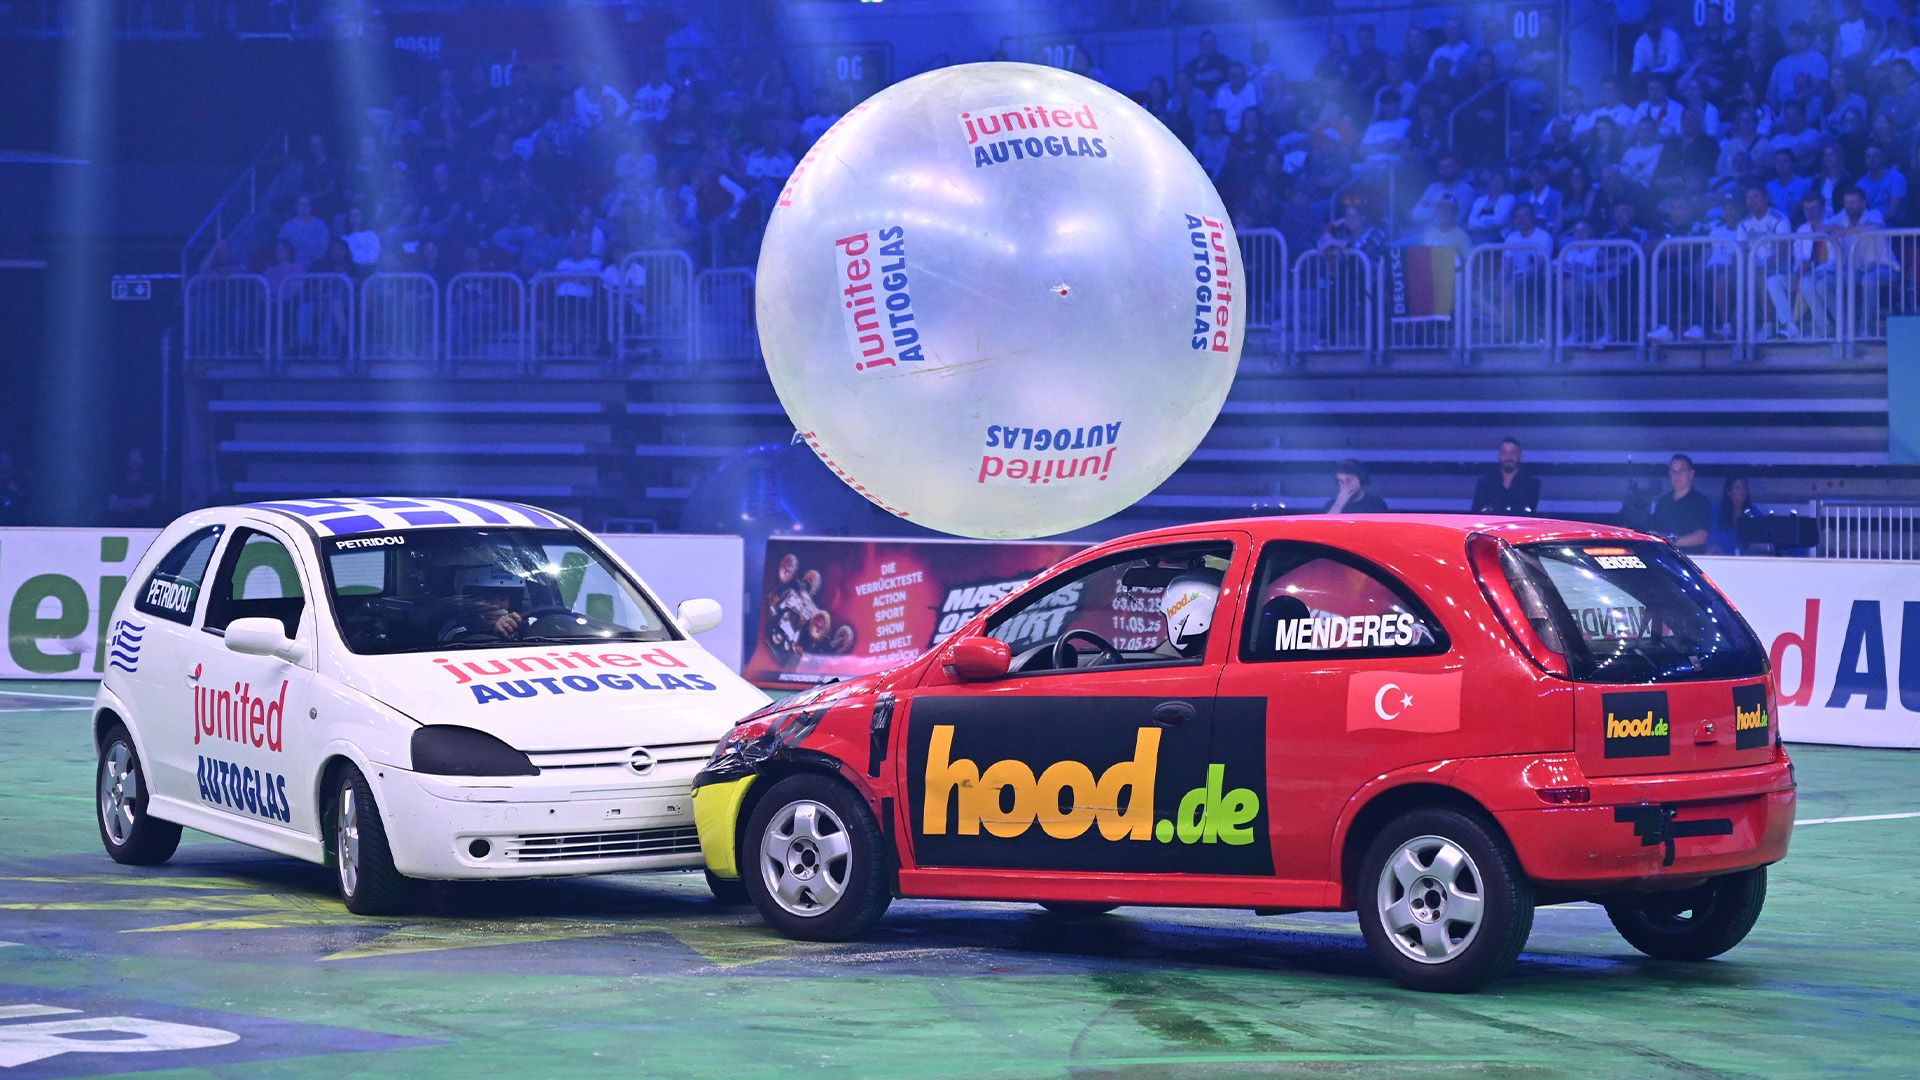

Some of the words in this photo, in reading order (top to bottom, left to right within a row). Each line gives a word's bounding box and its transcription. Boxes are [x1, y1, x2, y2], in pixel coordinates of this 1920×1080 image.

[962, 104, 1098, 145] junited
[974, 135, 1108, 169] AUTOGLAS
[879, 225, 925, 362] AUTOGLAS
[1184, 213, 1213, 351] AUTOGLAS
[1202, 215, 1233, 353] junited
[835, 232, 897, 371] junited
[985, 420, 1122, 452] AUTOGLAS
[977, 446, 1118, 484] junited
[335, 535, 405, 550] PETRIDOU
[855, 571, 924, 596] VERRÜCKTESTE
[881, 562, 897, 576] DIE
[146, 578, 193, 614] PETRIDOU
[873, 591, 907, 607] ACTION
[875, 606, 905, 622] SPORT
[876, 621, 905, 637] SHOW
[1112, 615, 1161, 633] 11.05.25
[869, 641, 888, 653] DER
[888, 635, 912, 649] WELT
[1275, 612, 1416, 651] MENDERES
[432, 648, 689, 685] junited
[469, 673, 717, 705] AUTOGLAS
[194, 663, 289, 752] junited
[1606, 710, 1668, 739] hood.de
[1736, 703, 1768, 731] hood.de
[196, 755, 291, 824] AUTOGLAS
[922, 724, 1260, 846] hood.de
